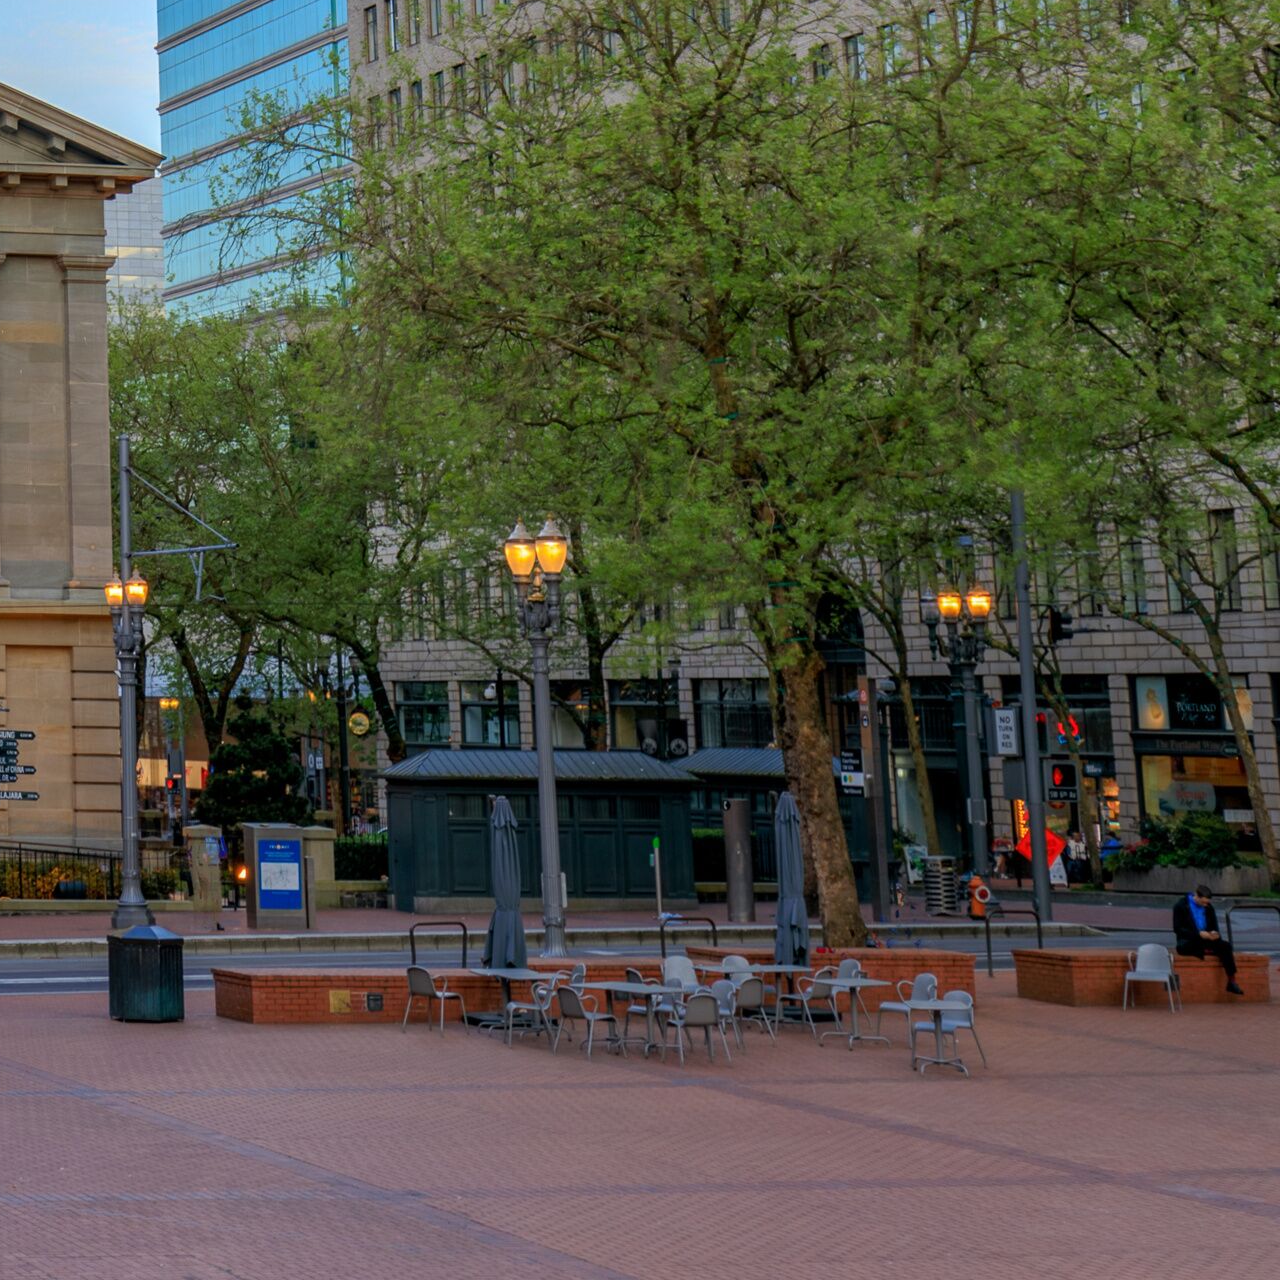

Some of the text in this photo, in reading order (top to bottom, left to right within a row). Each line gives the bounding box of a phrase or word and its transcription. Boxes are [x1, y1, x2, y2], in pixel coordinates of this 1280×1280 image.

[999, 715, 1011, 724] NO
[999, 724, 1013, 732] TURN
[1002, 740, 1013, 748] RED
